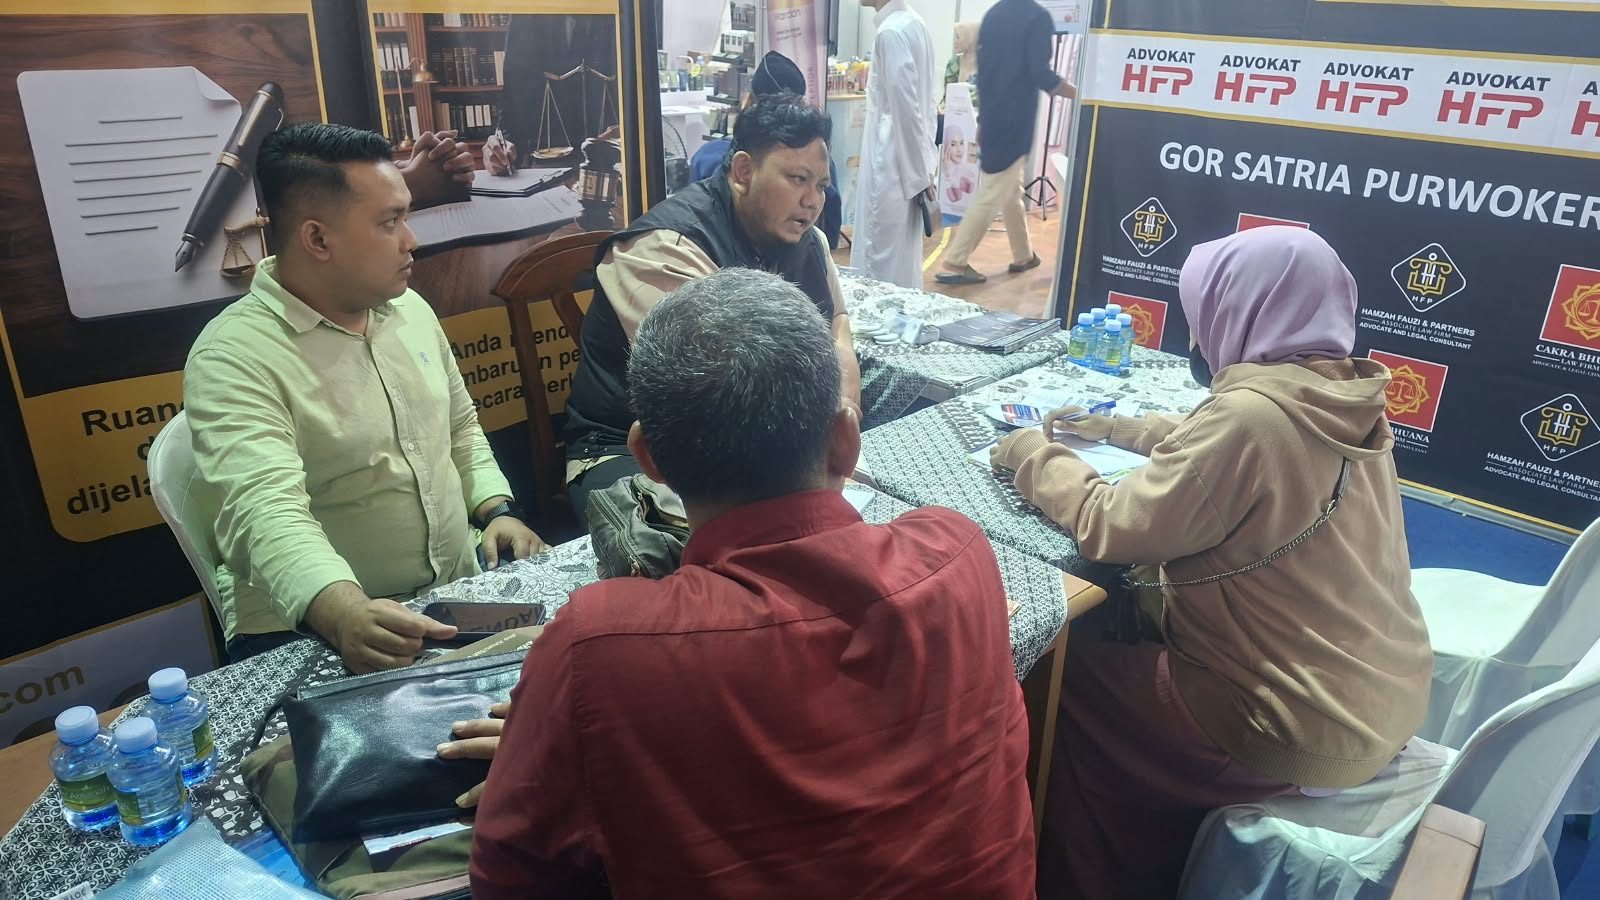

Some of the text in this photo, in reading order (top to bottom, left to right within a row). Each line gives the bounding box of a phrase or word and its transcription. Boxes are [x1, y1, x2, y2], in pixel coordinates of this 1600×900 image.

[1127, 48, 1196, 64] ADVOKAT
[1220, 55, 1301, 72] ADVOKAT
[1121, 63, 1193, 96] HFP
[1323, 62, 1414, 81] ADVOKAT
[1446, 71, 1551, 92] ADVOKAT
[1214, 71, 1297, 106] HFP
[1316, 79, 1408, 116] HFP
[1436, 89, 1544, 129] HFP
[1159, 141, 1225, 178] GOR
[1231, 150, 1350, 195] SATRIA
[1102, 267, 1123, 276] ADVOCATE
[1103, 255, 1126, 265] HAMZAH
[1127, 260, 1146, 268] FAUZI
[1412, 296, 1433, 304] HFP
[1361, 307, 1396, 320] HAMZAH
[1397, 314, 1420, 325] FAUZI
[1430, 321, 1475, 337] PARTNERS
[1381, 320, 1451, 338] ASSOCIATE LAW FIRM
[1359, 322, 1472, 350] ADVOCATE AND LEGAL CONSULTANT
[1536, 344, 1575, 359] CAKRA
[1561, 358, 1578, 366] LAW
[1543, 444, 1566, 454] HFP
[1484, 466, 1520, 480] ADVOCATE
[1521, 476, 1535, 484] AND
[1536, 480, 1559, 491] LEGAL
[1487, 452, 1524, 467] HAMZAH
[1526, 462, 1552, 474] FAUZI
[1562, 472, 1600, 488] PARTNE
[1508, 466, 1585, 490] ASSOCIATE LAW FIRM
